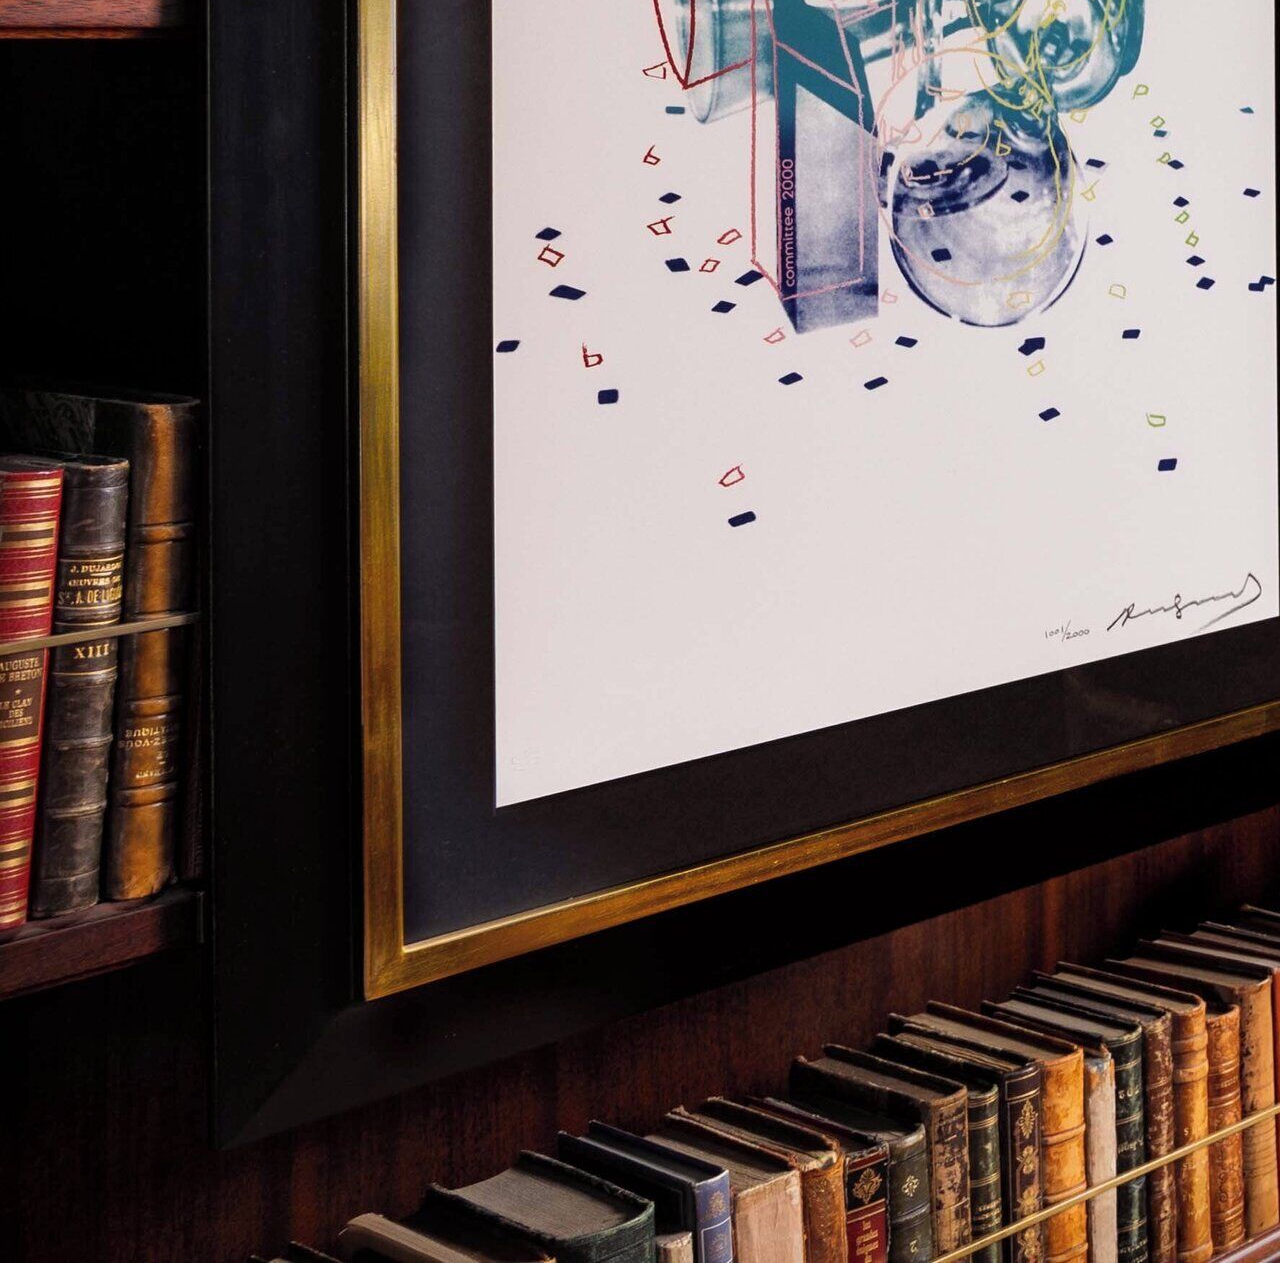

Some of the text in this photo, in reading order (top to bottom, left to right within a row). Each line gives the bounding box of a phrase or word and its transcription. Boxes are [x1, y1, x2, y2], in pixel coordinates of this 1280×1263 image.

[781, 158, 795, 288] committee 2000
[74, 642, 110, 660] XIII
[8, 668, 43, 682] BRETON
